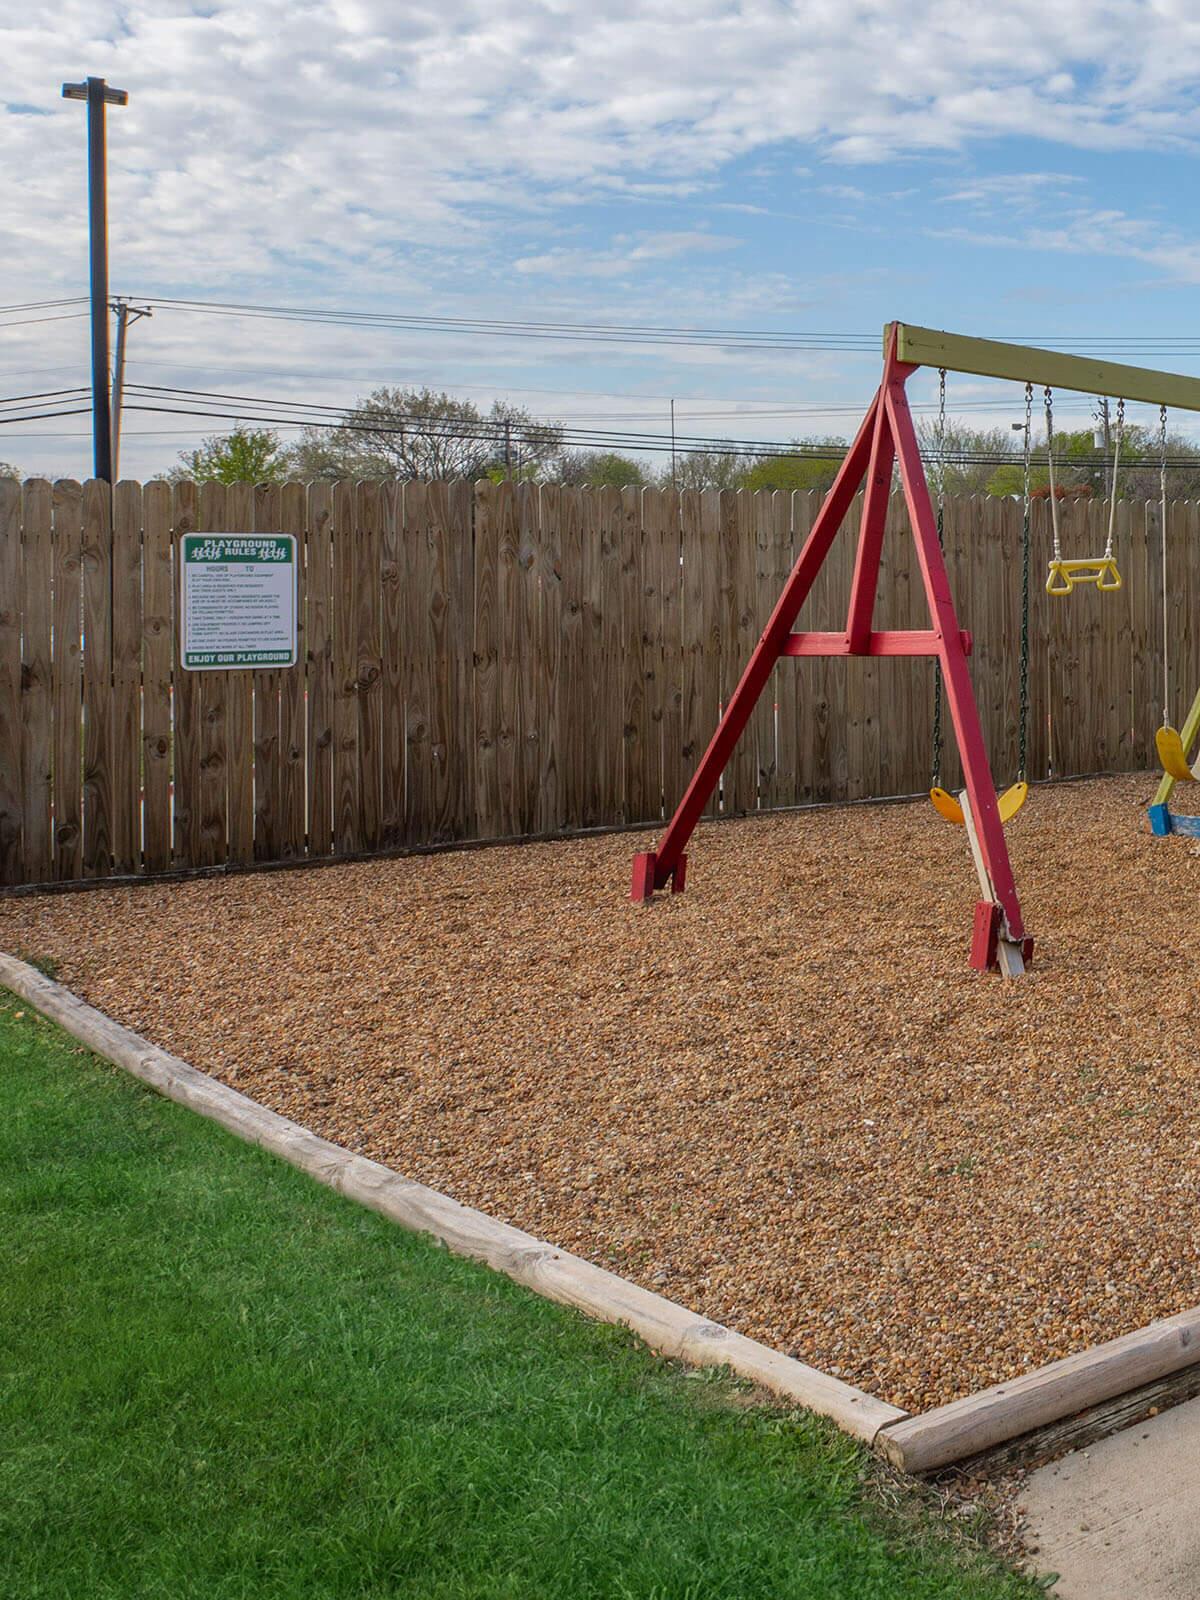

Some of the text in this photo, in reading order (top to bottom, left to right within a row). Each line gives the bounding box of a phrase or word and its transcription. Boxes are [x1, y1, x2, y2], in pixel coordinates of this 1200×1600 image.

[204, 539, 277, 548] PLAYGROUND
[224, 548, 257, 556] RULES
[188, 652, 290, 664] ENJOY OUR PLAYGROUND
